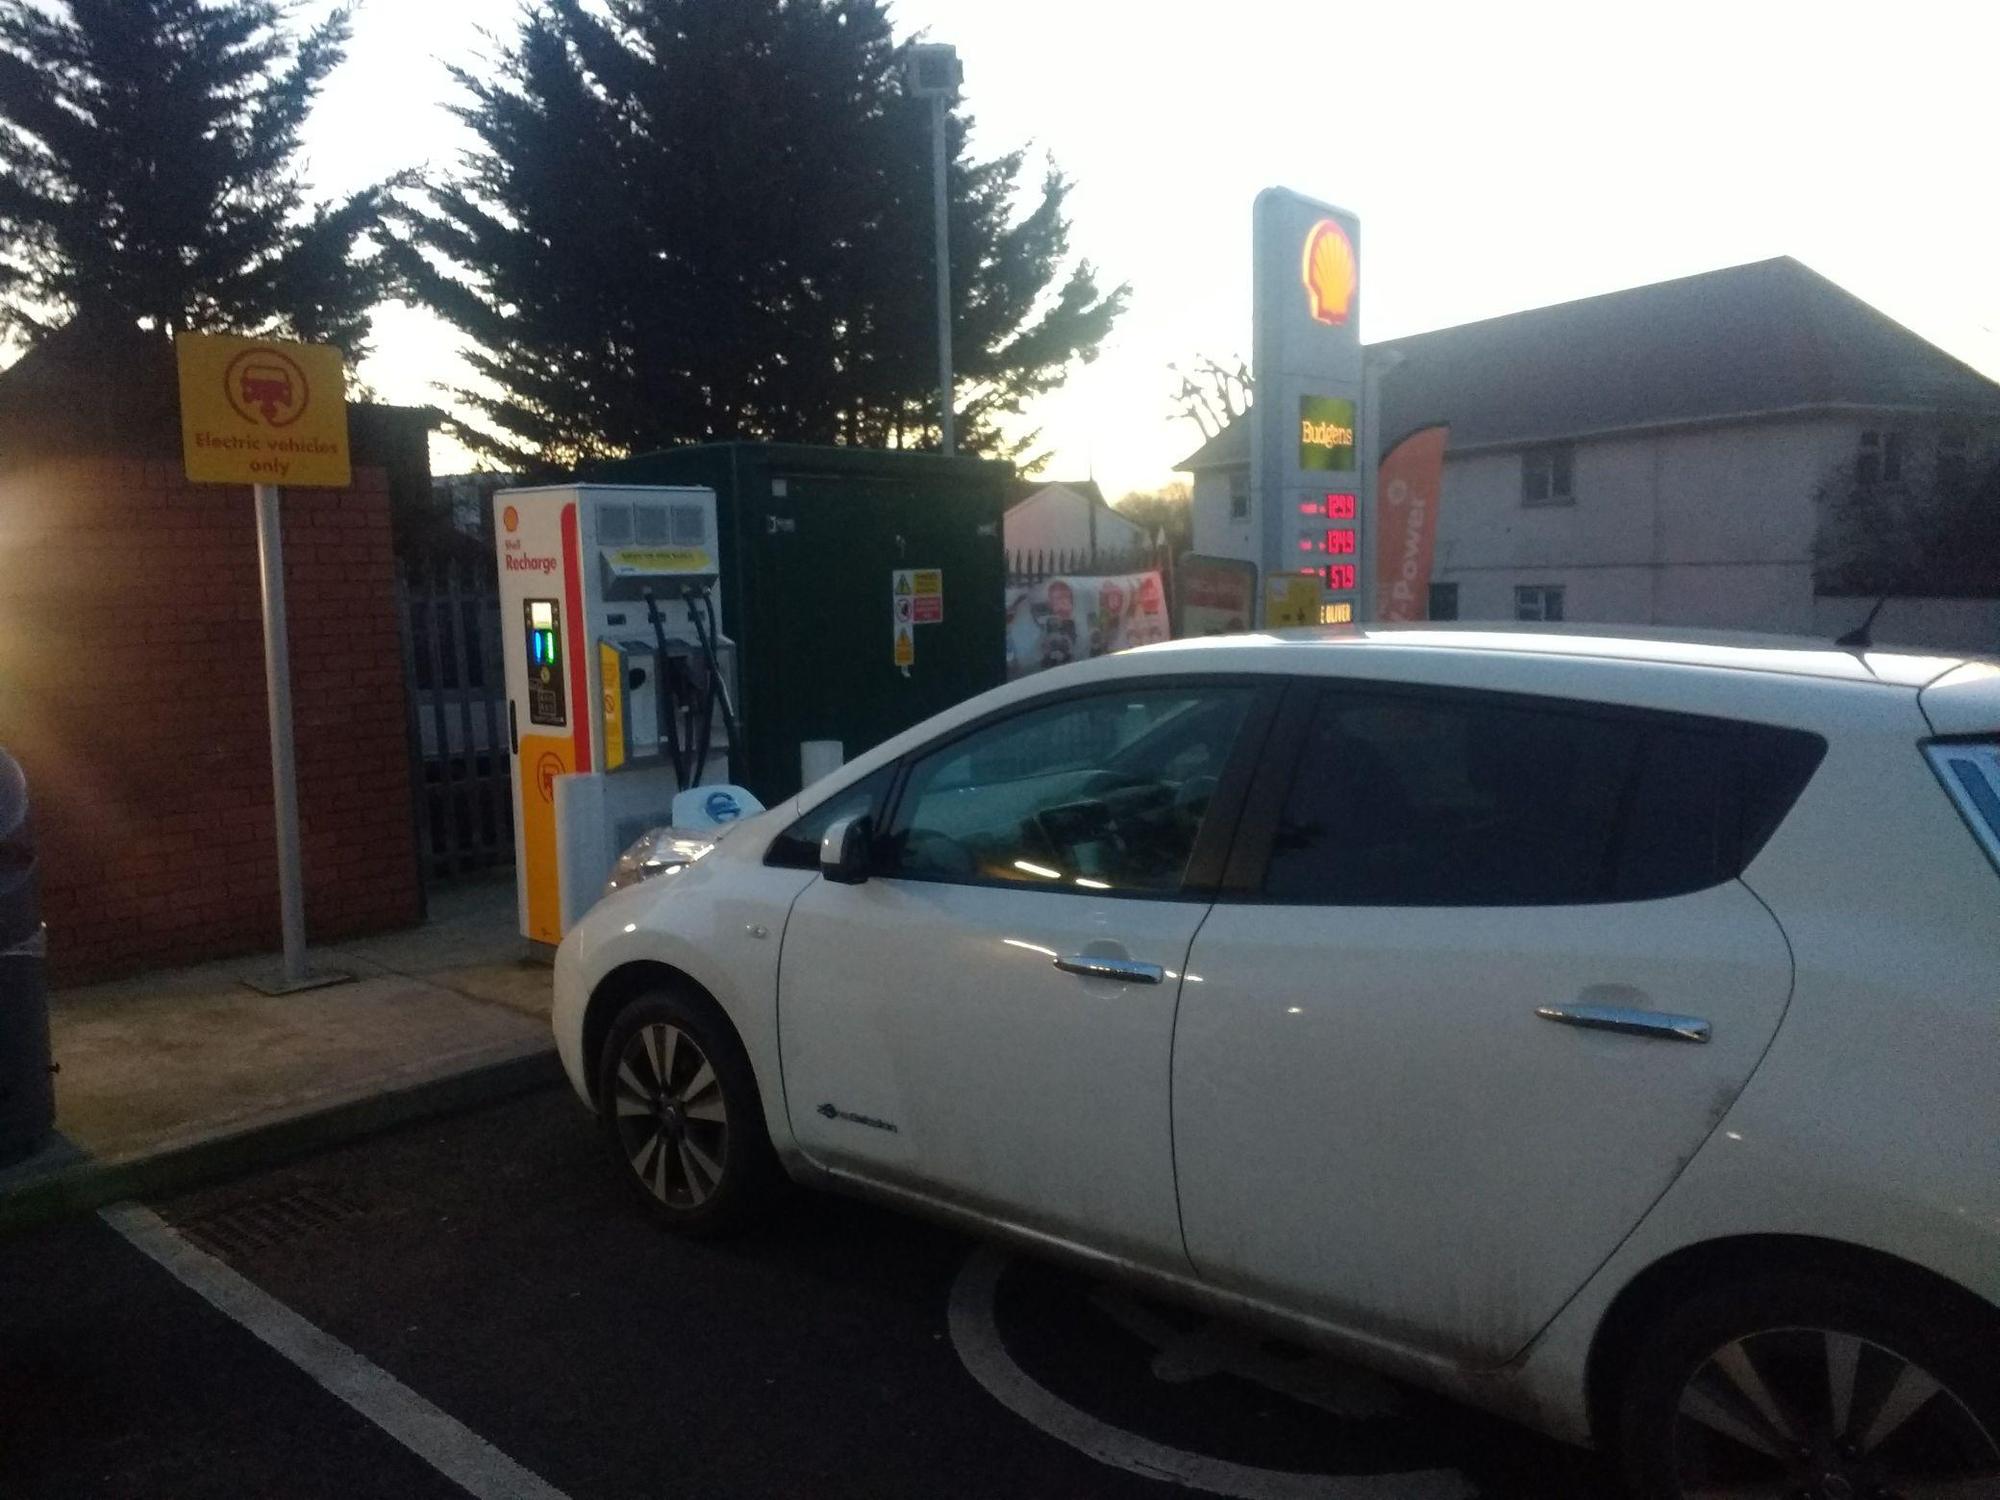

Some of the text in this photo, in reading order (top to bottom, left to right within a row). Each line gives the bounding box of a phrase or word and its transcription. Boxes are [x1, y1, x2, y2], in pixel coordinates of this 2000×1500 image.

[194, 431, 338, 454] Electric vehicles
[1302, 420, 1352, 449] Budgens
[249, 457, 290, 477] only
[505, 552, 557, 575] Recharge
